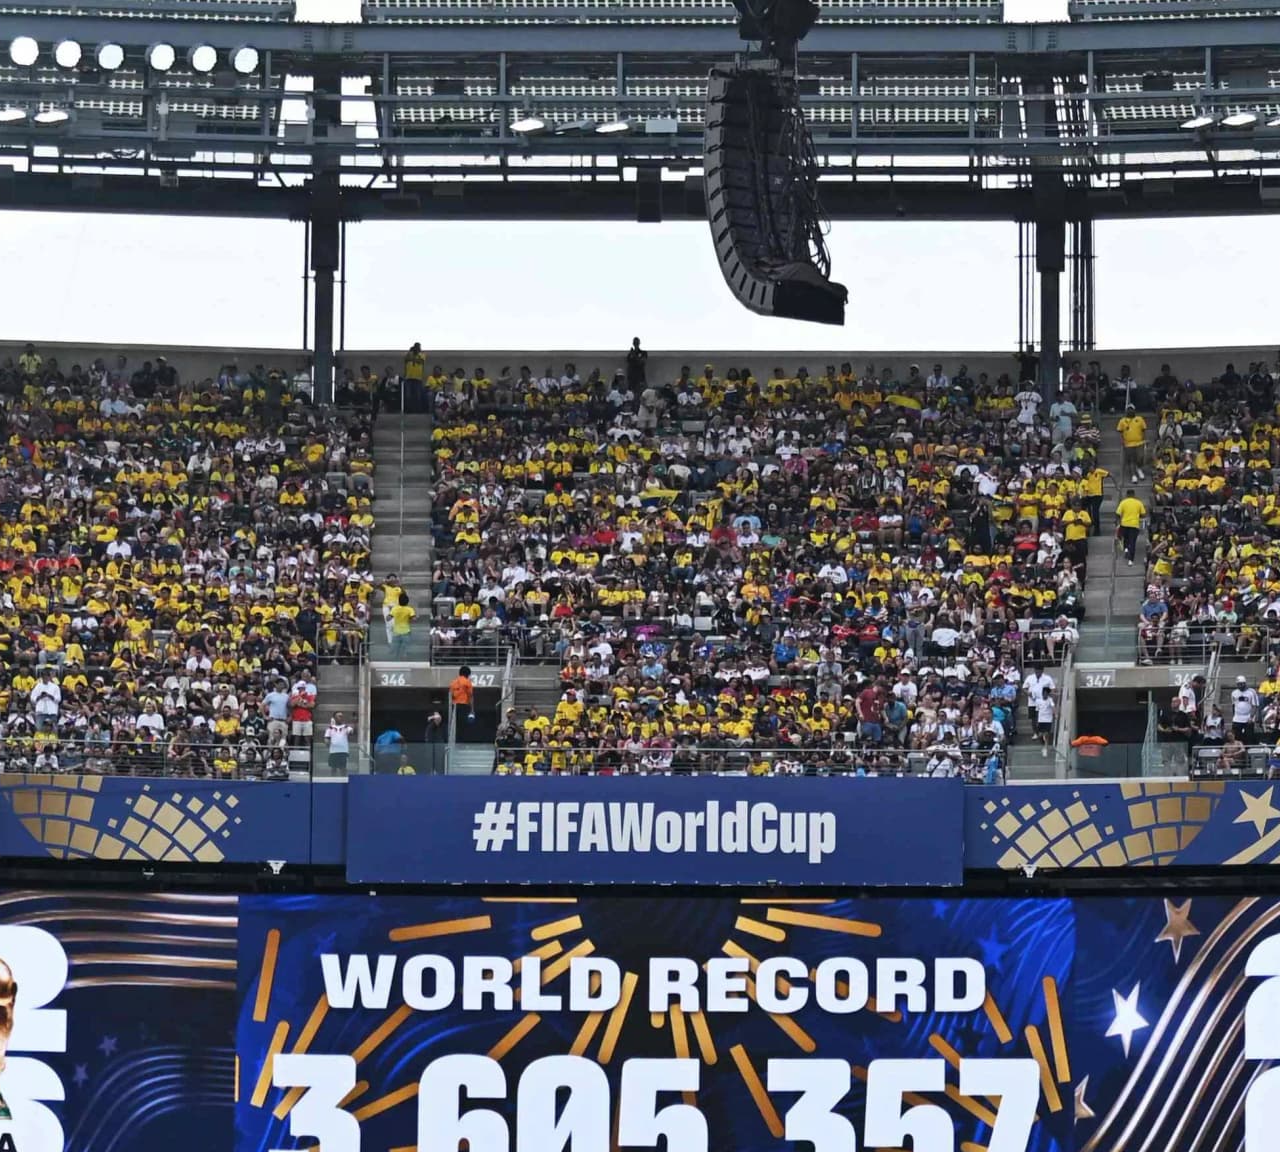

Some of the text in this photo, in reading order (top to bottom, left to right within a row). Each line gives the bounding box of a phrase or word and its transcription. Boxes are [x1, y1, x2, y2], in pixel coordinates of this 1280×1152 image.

[380, 673, 404, 685] 346
[471, 673, 493, 685] 347
[1085, 674, 1110, 686] 347
[474, 801, 835, 863] #FIFAWorldCup
[322, 955, 985, 1013] WORLD RECORD
